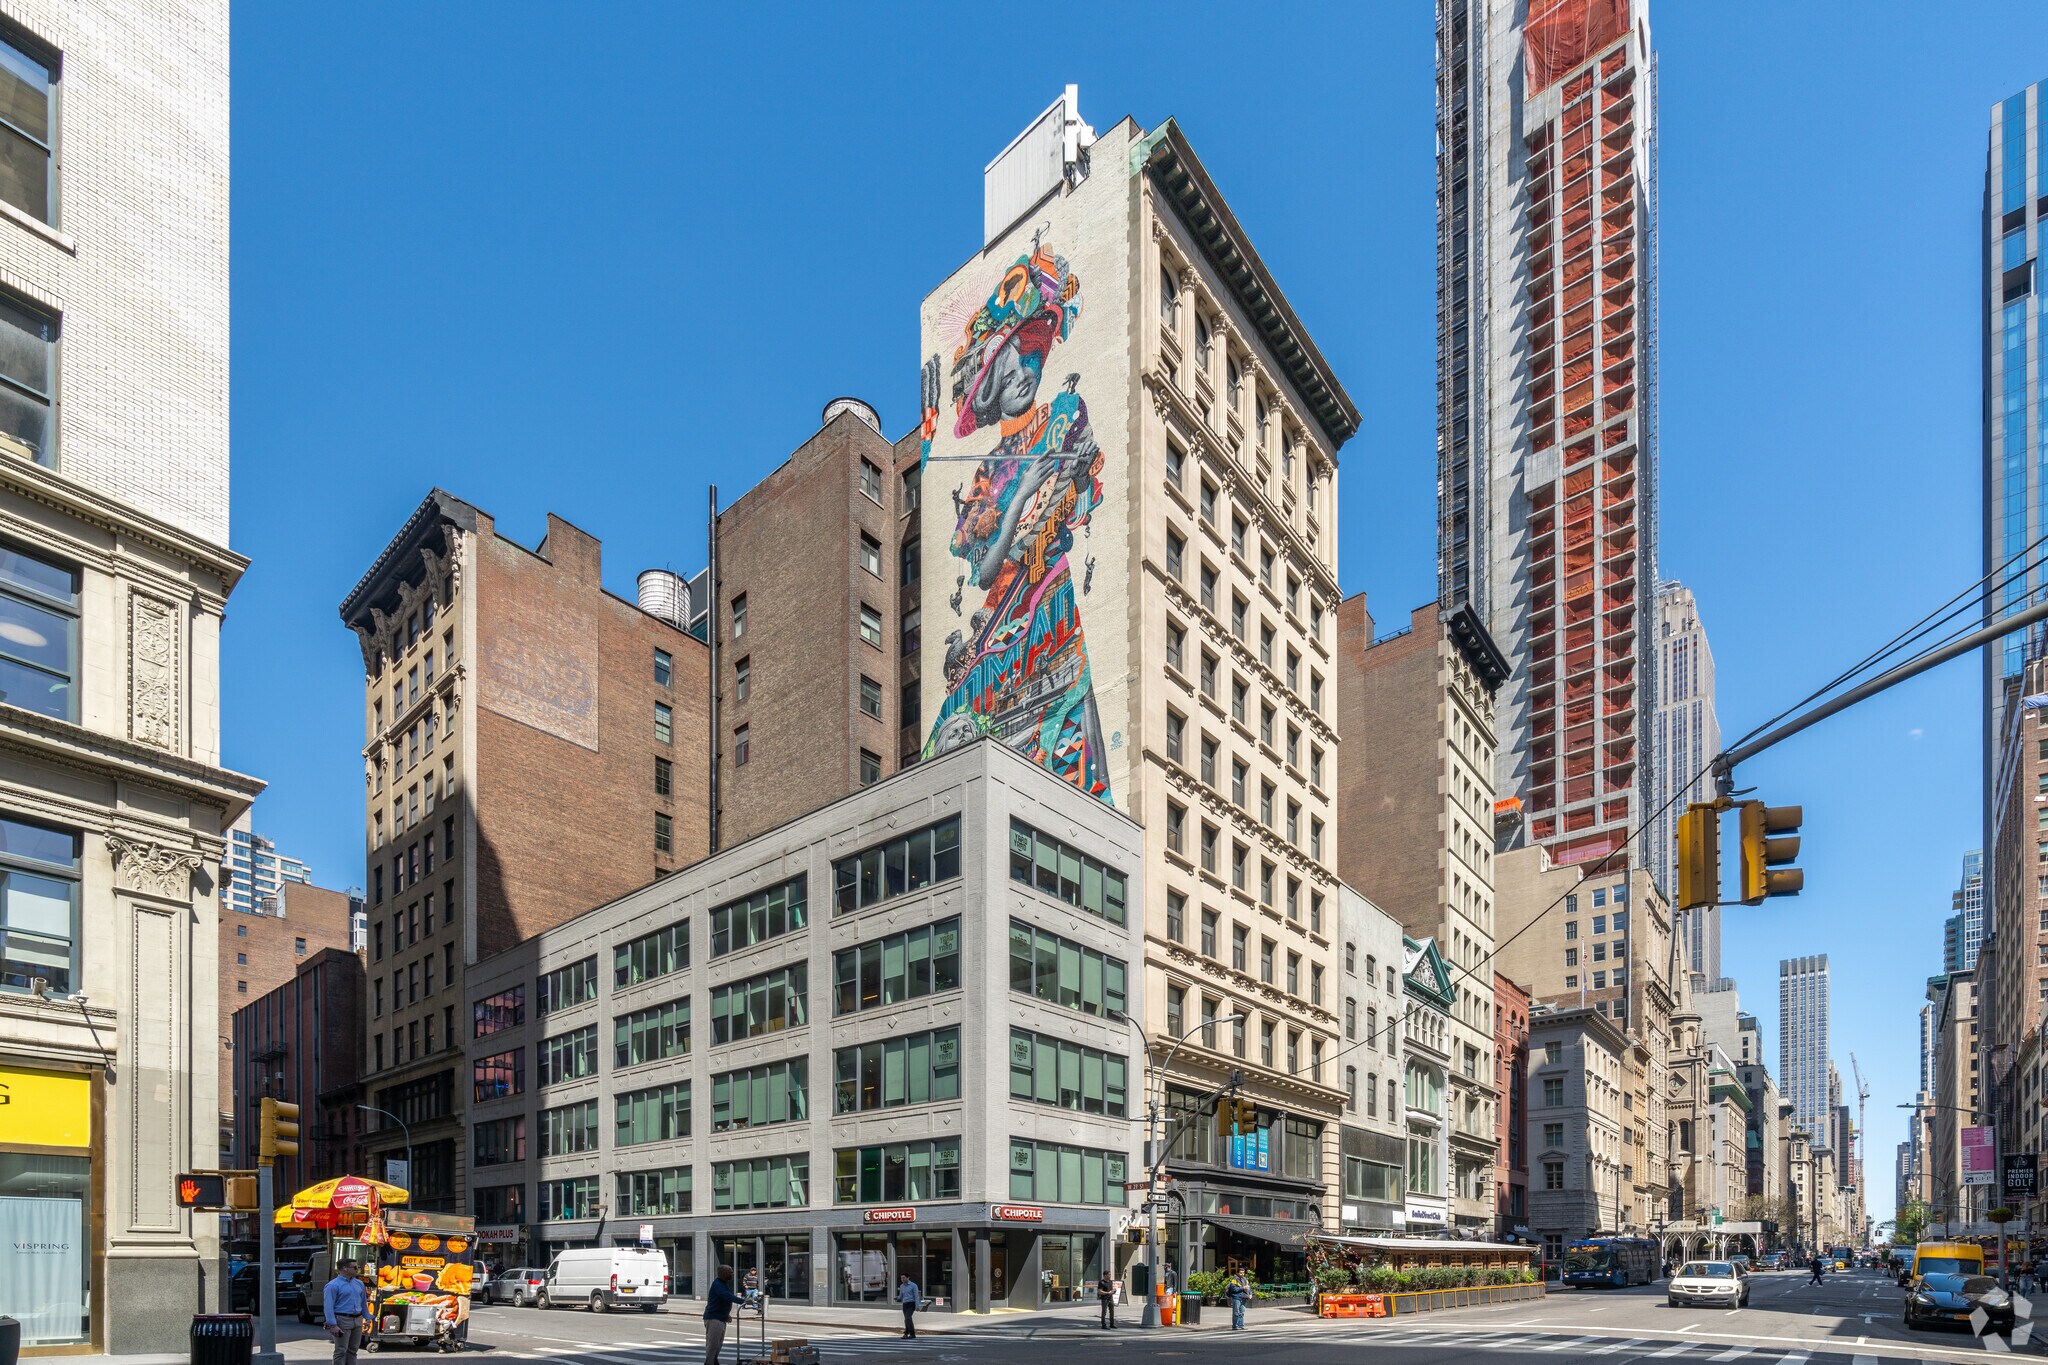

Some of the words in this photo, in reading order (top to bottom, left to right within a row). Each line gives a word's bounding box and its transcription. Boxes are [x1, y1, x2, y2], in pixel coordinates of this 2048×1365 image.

[940, 934, 953, 943] YARD
[940, 1042, 954, 1051] YARD
[1015, 1043, 1028, 1053] YARD
[2007, 1179, 2034, 1187] GOLF
[873, 1210, 912, 1220] CHIPOTLE
[1004, 1208, 1042, 1218] CHIPOTLE
[477, 1230, 498, 1239] OOKAH
[499, 1229, 514, 1239] PLUS
[13, 1242, 70, 1250] VISPRING
